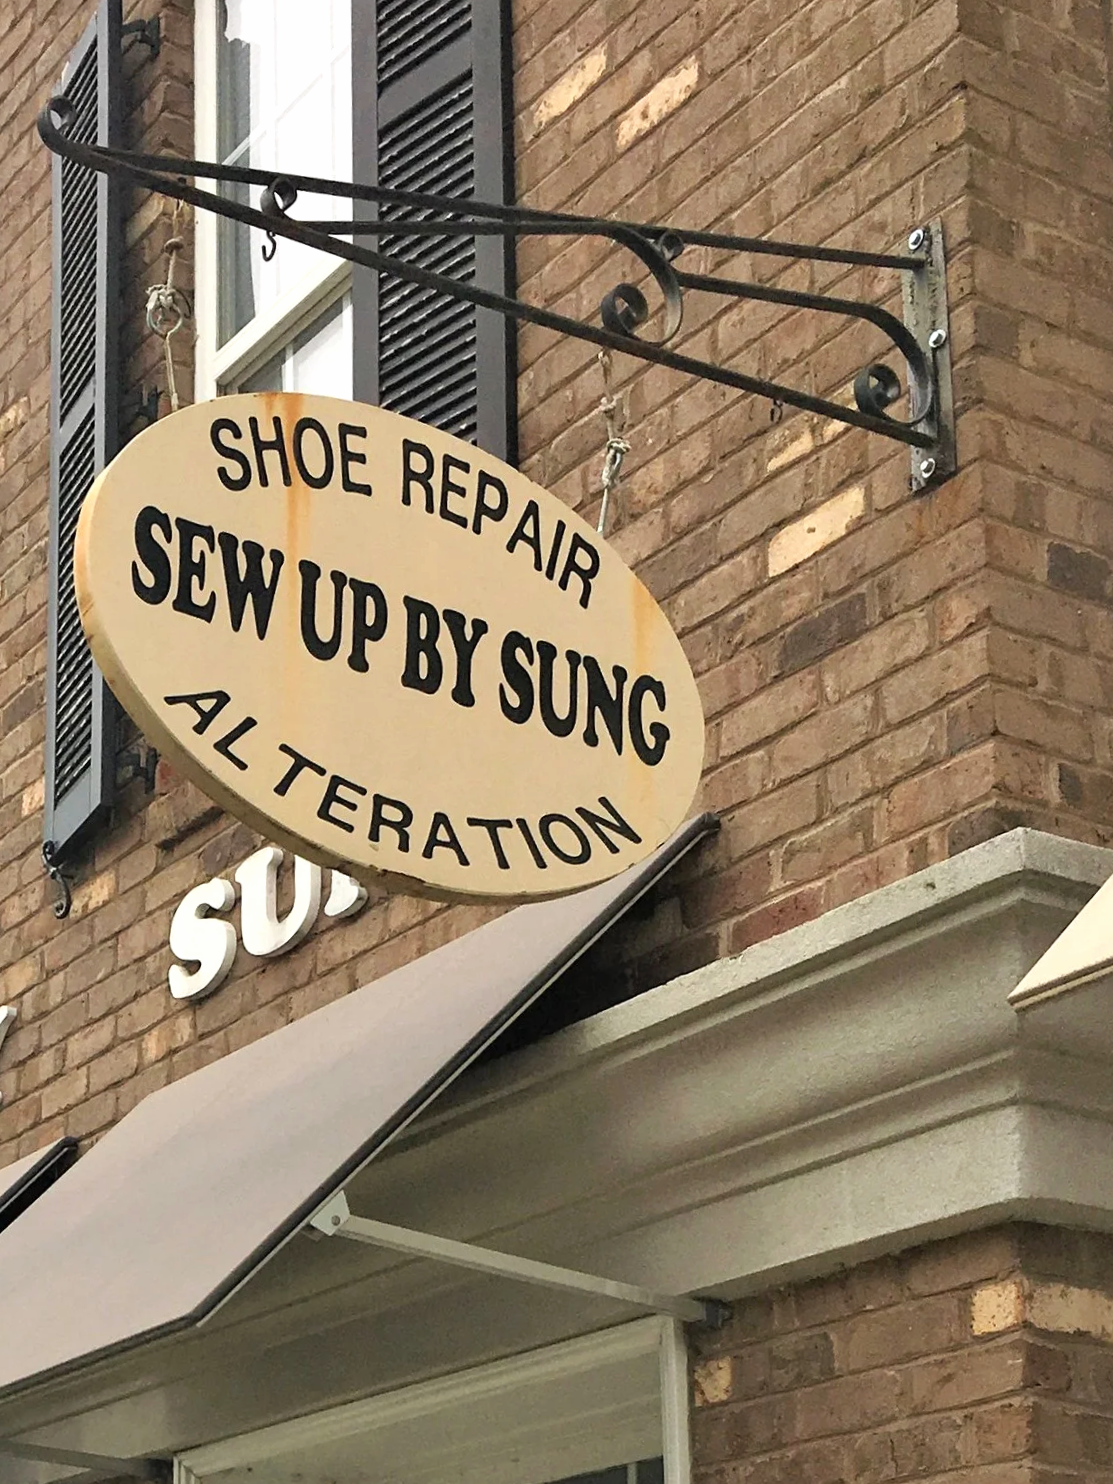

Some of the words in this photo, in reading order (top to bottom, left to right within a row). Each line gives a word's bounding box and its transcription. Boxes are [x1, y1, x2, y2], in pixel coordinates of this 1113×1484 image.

[210, 416, 373, 496] SHOE
[402, 439, 601, 609] REPAIR
[131, 505, 284, 641] SEW
[298, 559, 387, 673] UP
[401, 596, 489, 707] BY
[499, 630, 671, 767] SUNG
[164, 689, 643, 871] ALTERATION
[167, 846, 368, 999] SU
